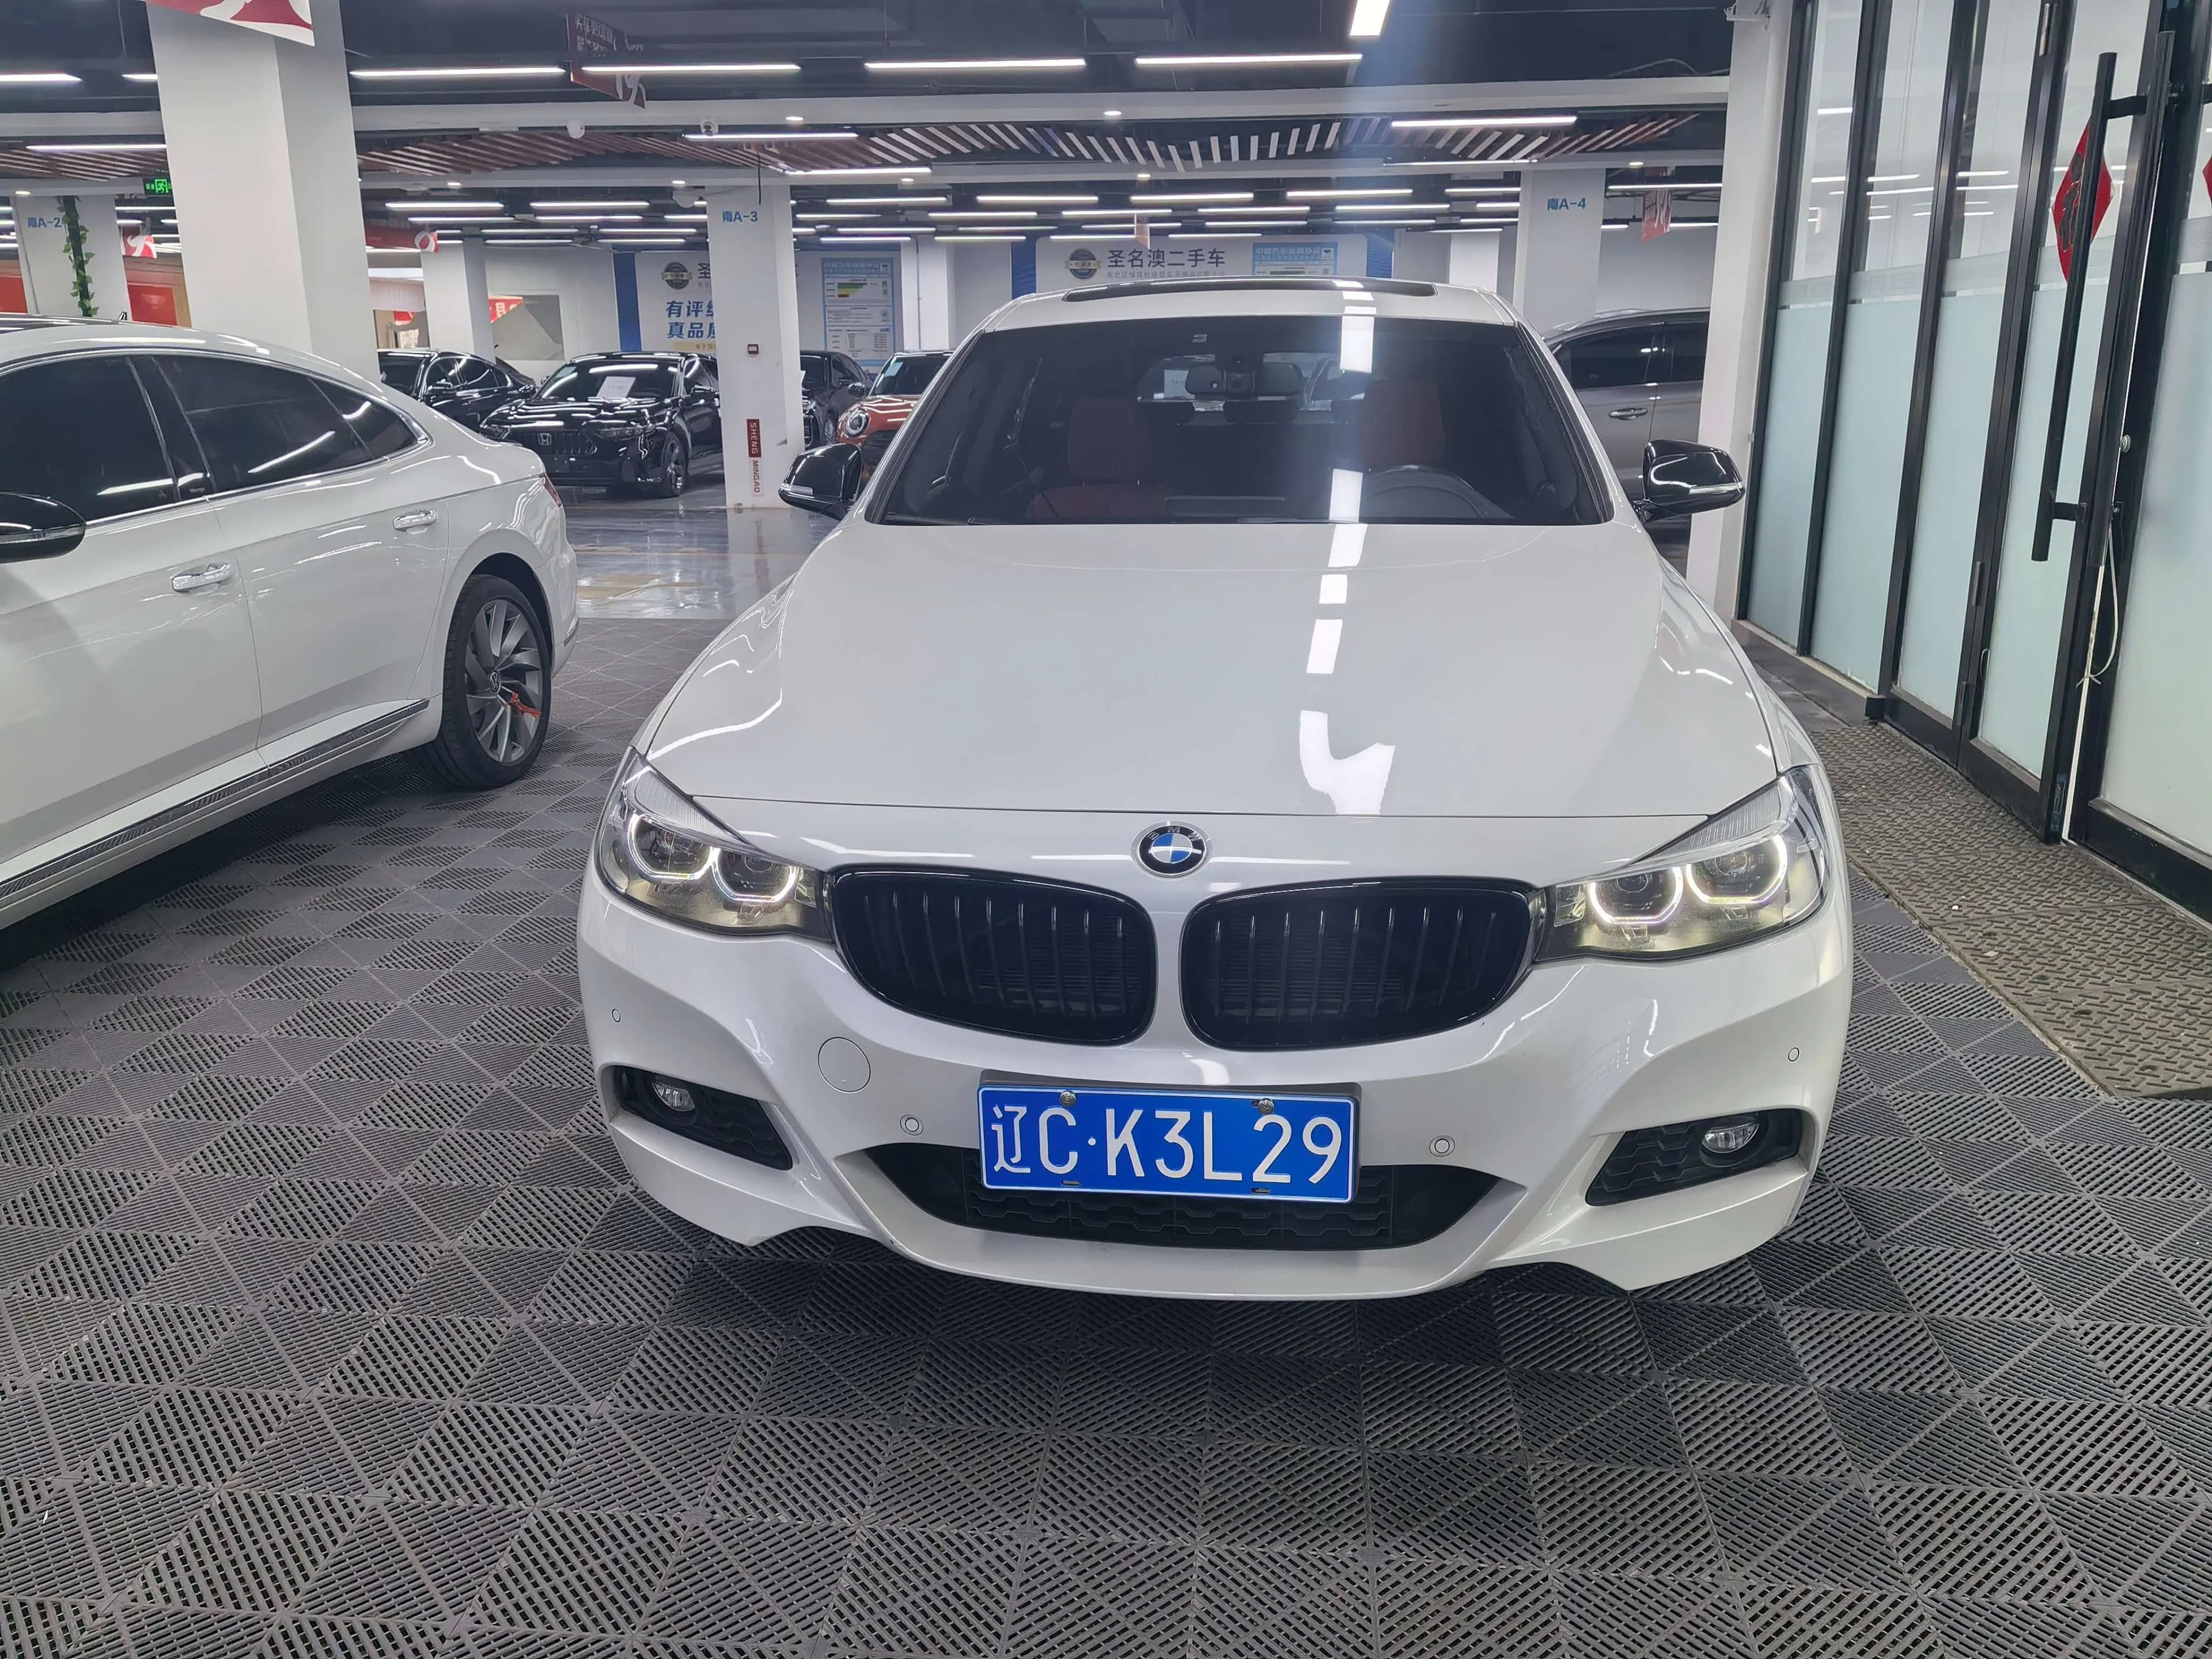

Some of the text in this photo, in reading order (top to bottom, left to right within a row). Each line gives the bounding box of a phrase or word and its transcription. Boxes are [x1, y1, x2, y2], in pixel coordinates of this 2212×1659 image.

[1107, 248, 1226, 268] 圣名澳二手车
[749, 422, 760, 493] SHENG MINGAO
